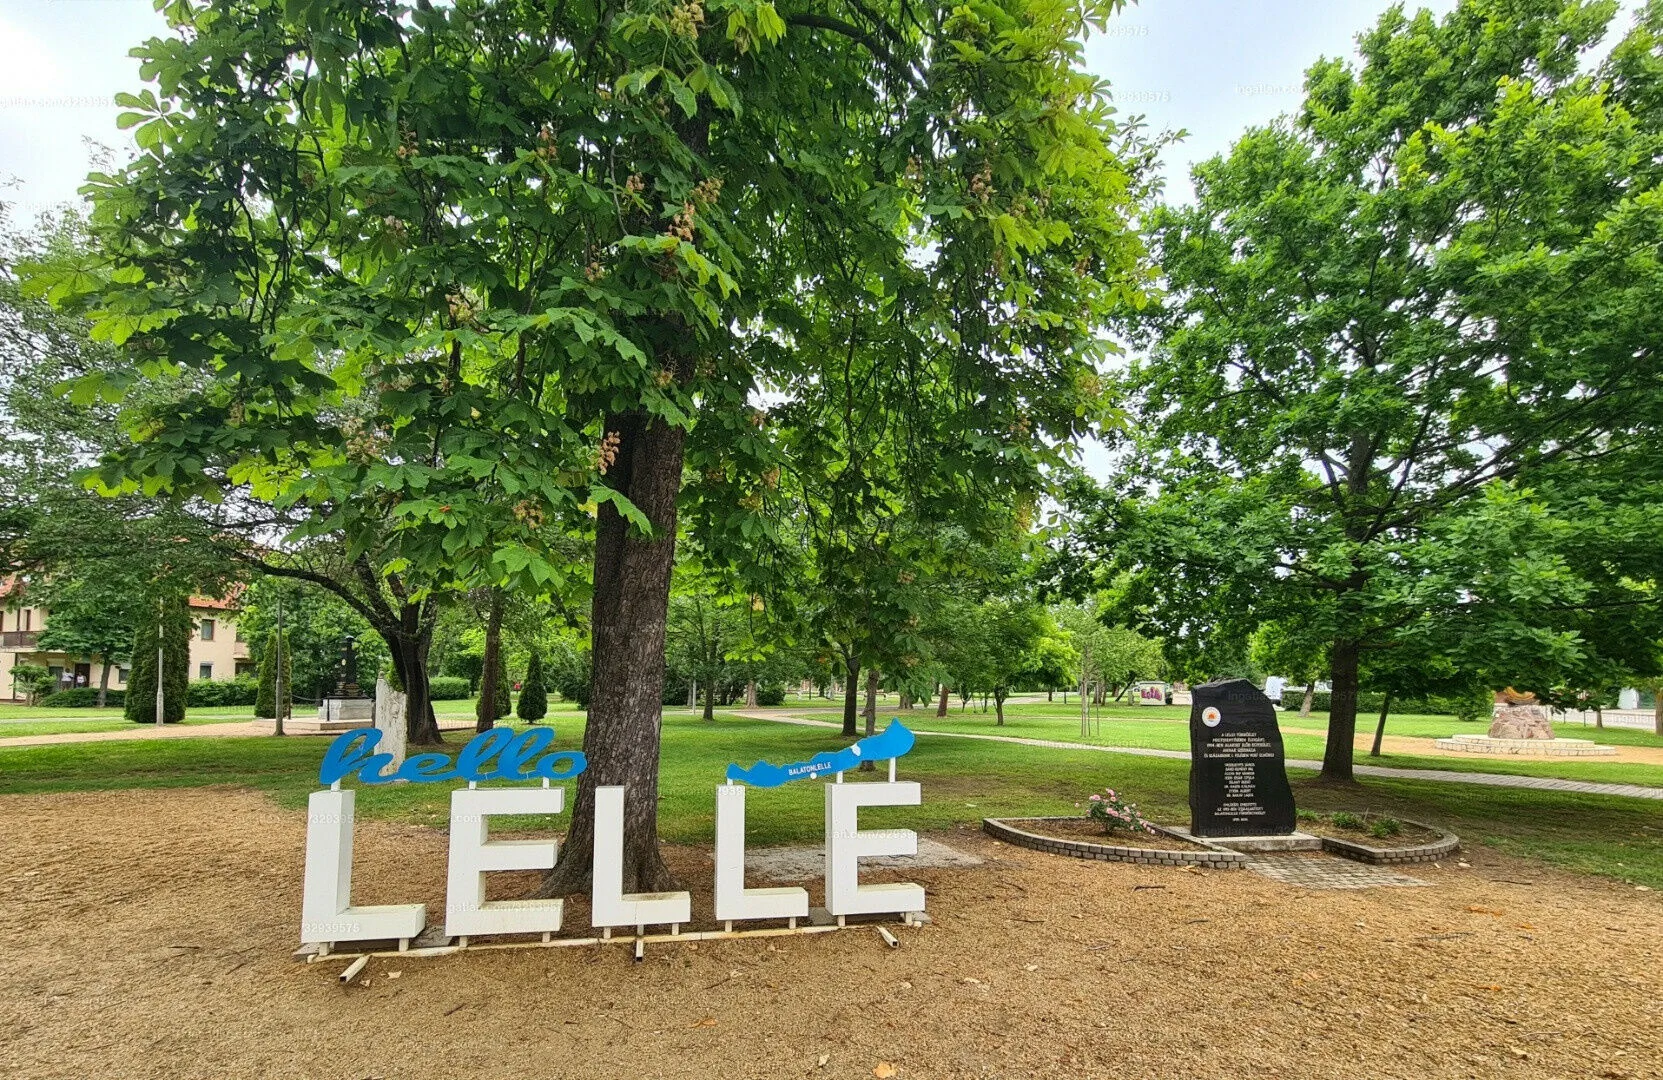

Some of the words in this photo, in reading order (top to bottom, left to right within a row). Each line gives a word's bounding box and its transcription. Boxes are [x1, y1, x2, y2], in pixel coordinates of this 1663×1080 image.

[319, 726, 587, 785] hello
[788, 761, 832, 776] BALATONLELLE
[301, 782, 925, 943] LELLE
